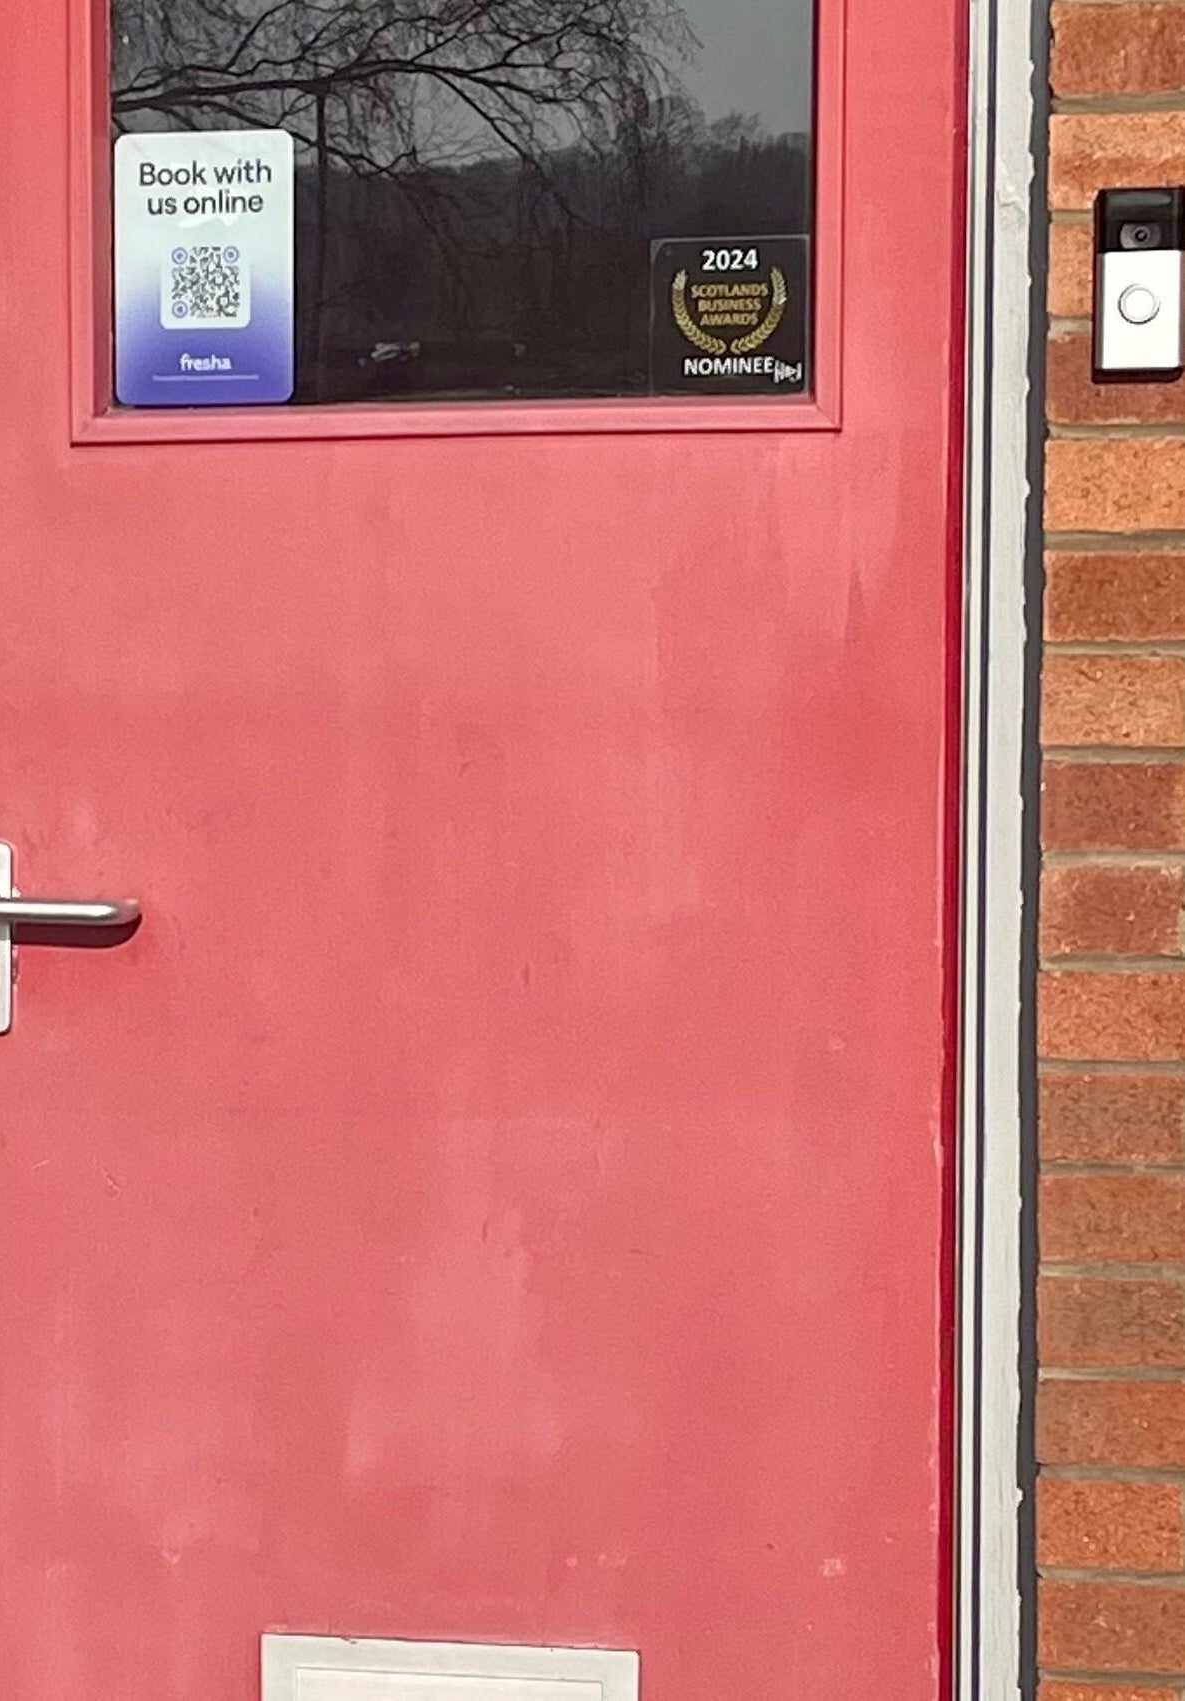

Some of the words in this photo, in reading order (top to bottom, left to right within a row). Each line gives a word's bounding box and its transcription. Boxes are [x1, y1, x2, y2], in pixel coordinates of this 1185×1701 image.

[139, 160, 208, 187] Book
[214, 157, 272, 185] with
[147, 196, 178, 216] us
[183, 190, 264, 215] online
[701, 248, 758, 271] 2024
[690, 283, 769, 298] SCOTLANDS
[697, 299, 762, 313] BUSINESS
[699, 313, 759, 326] AWARDS
[179, 352, 233, 372] fresha
[683, 356, 775, 375] NOMINEE
